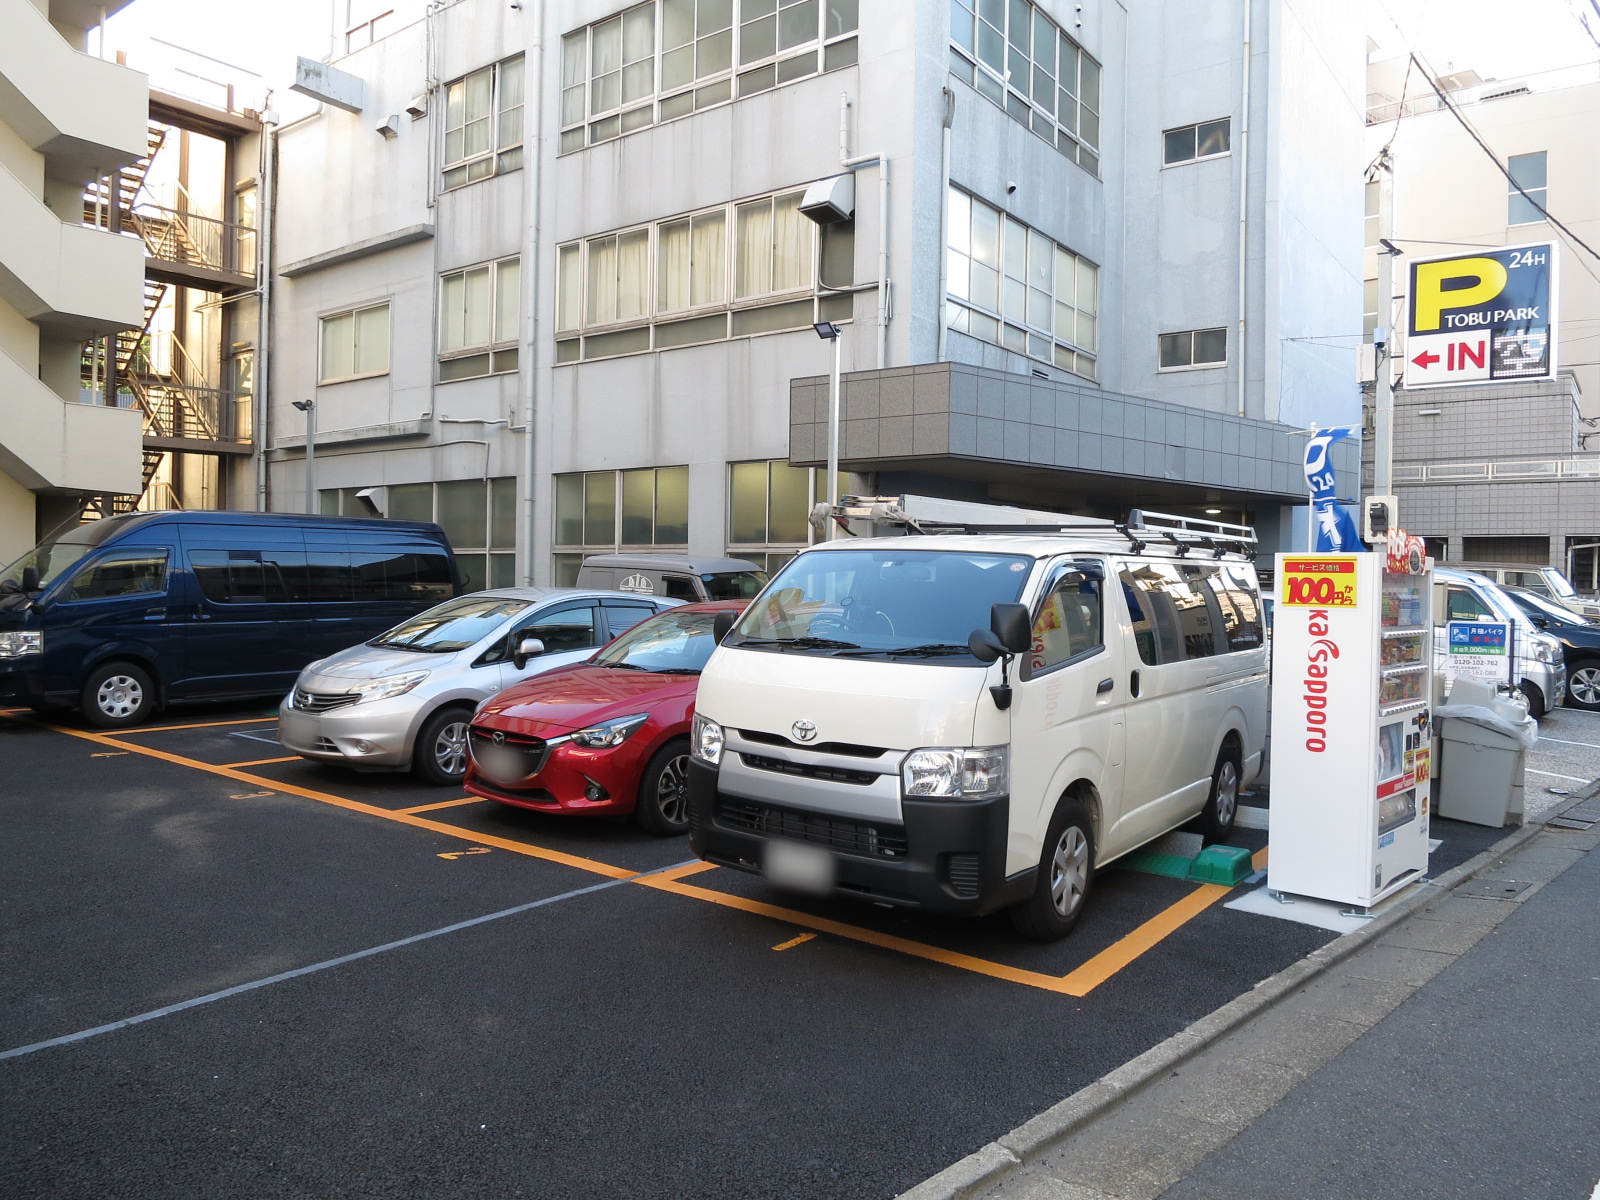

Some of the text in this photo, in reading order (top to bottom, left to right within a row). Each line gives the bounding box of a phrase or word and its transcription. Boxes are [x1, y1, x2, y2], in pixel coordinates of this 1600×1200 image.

[1508, 250, 1546, 269] 24H
[1414, 257, 1508, 332] P
[1444, 306, 1540, 328] TOBU PARK
[1447, 340, 1486, 371] IN
